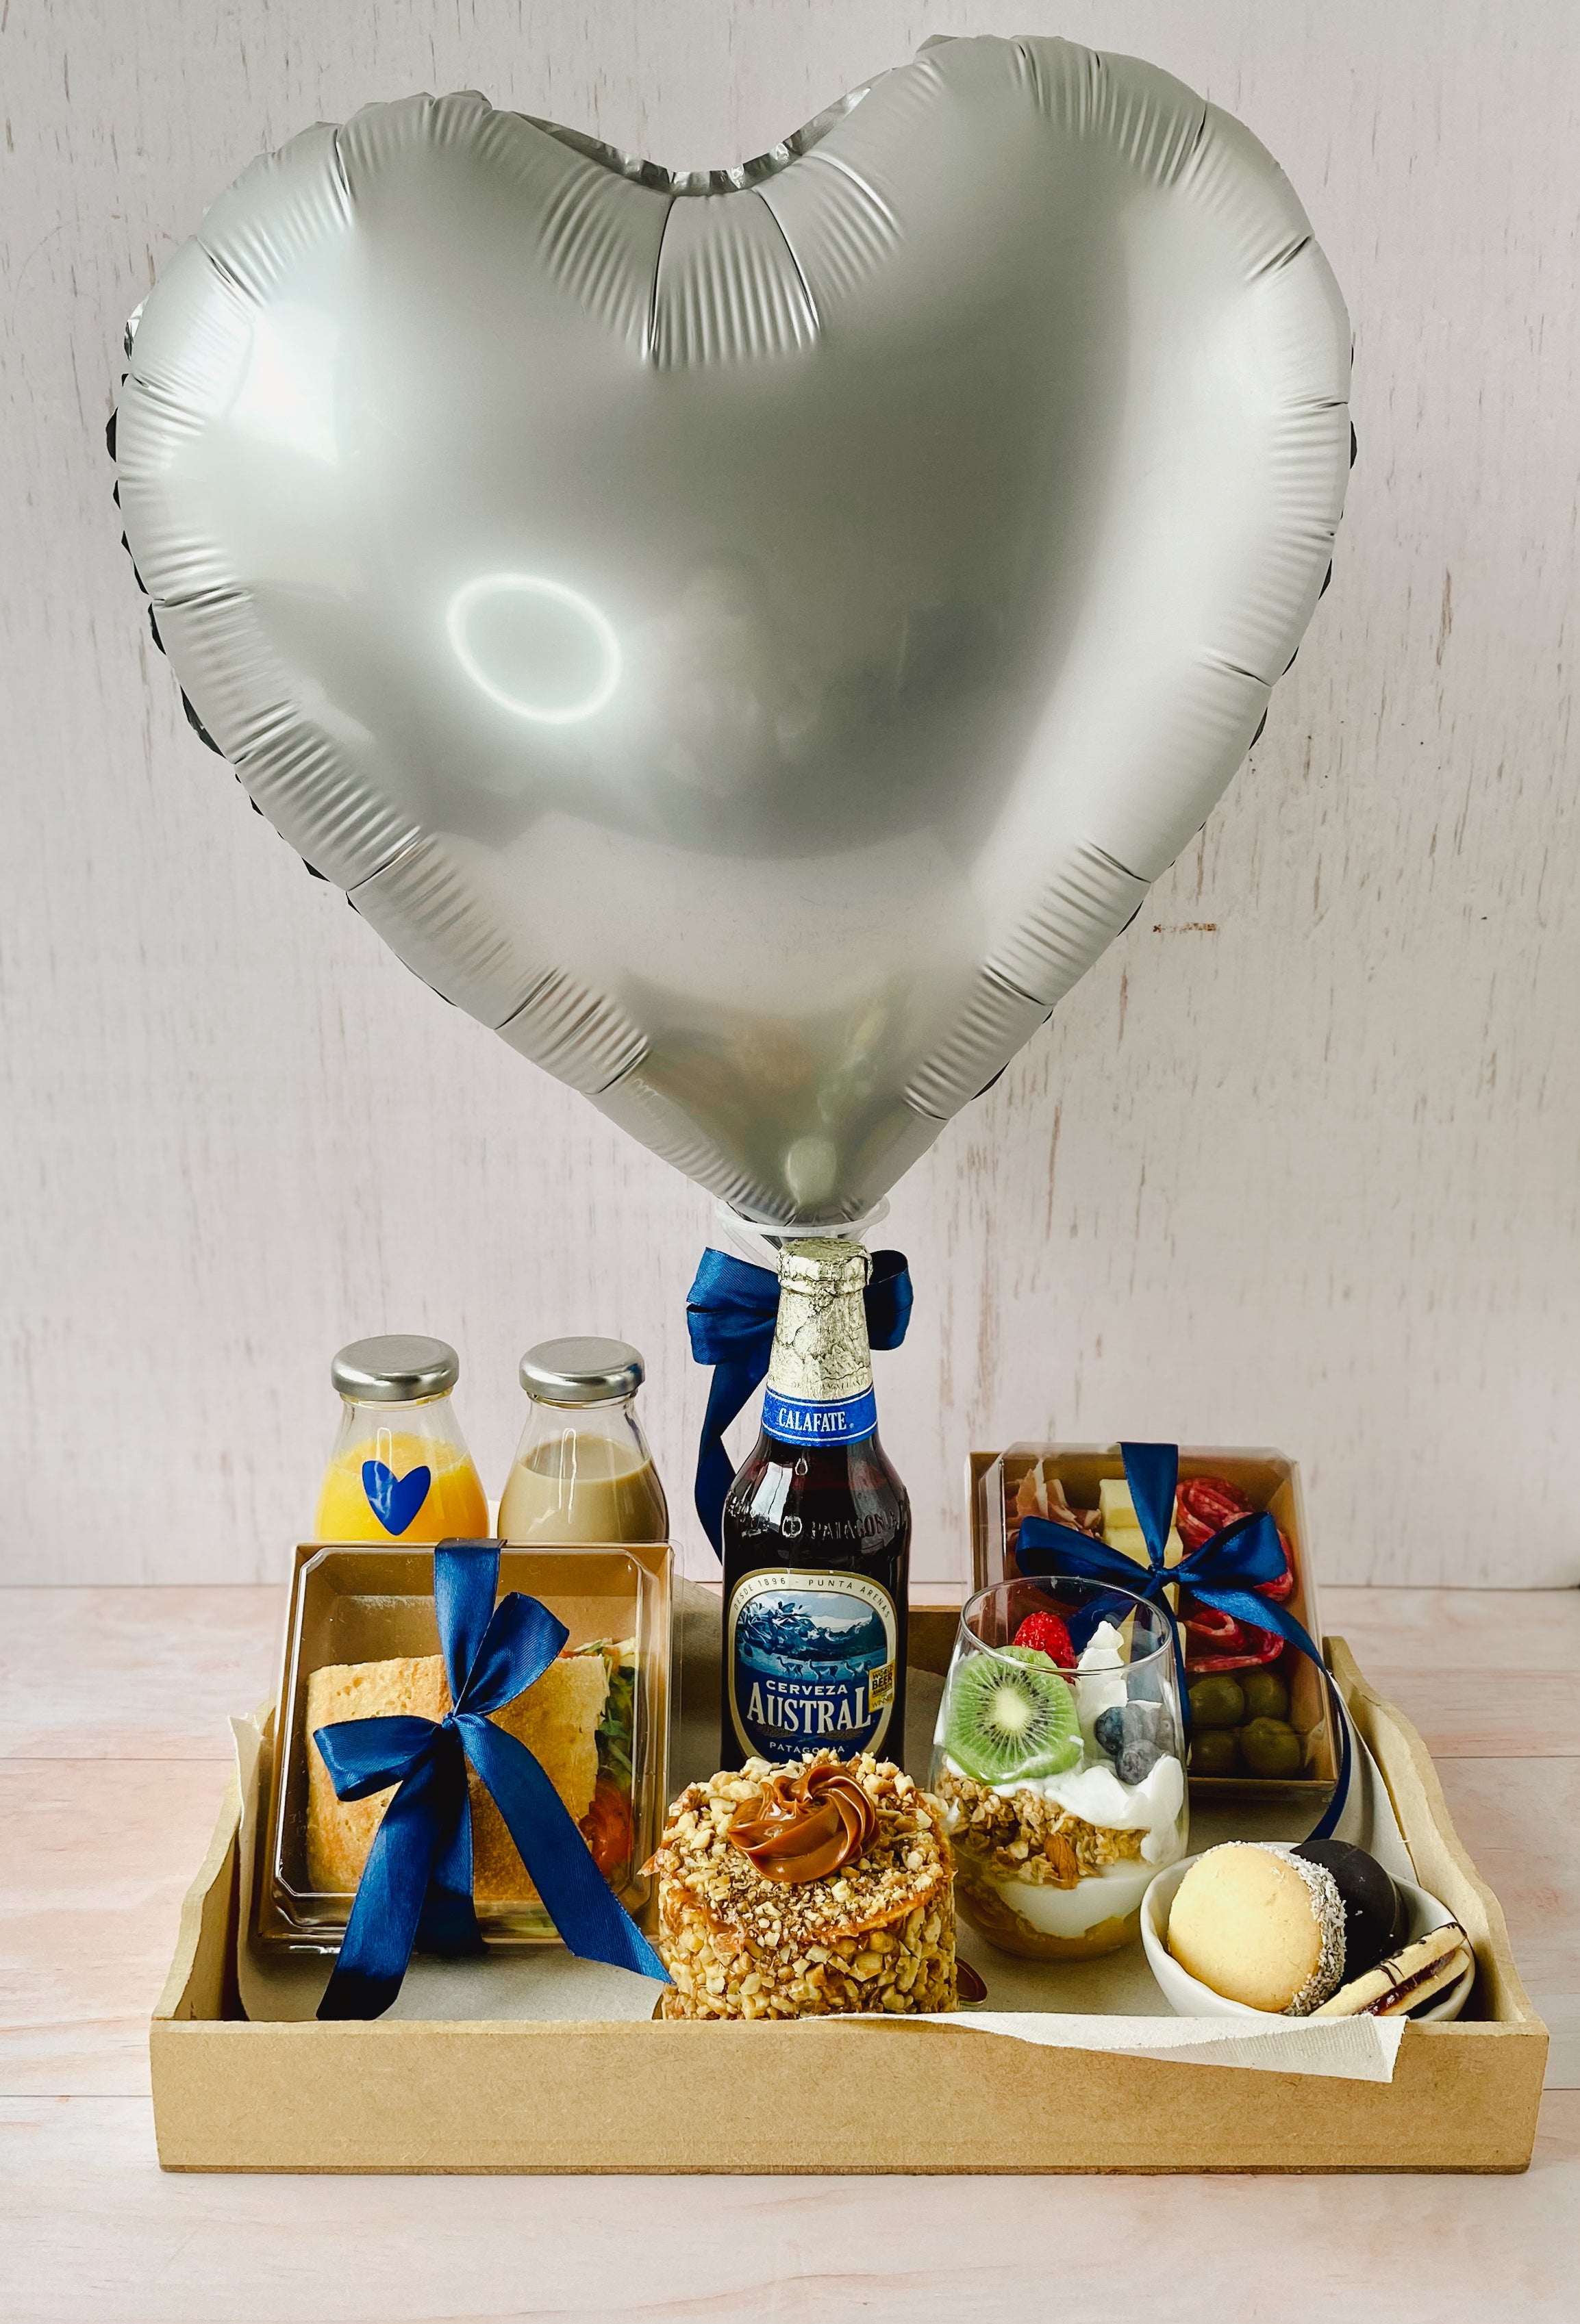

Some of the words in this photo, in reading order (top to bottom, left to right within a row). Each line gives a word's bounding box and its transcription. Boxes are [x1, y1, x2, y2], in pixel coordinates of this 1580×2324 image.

[779, 1408, 847, 1432] CALAFATE
[733, 1584, 753, 1611] DESDE
[757, 1577, 786, 1587] 1896
[808, 1579, 853, 1589] PUNTA
[860, 1586, 890, 1618] ARENAS
[766, 1680, 848, 1696] CERVEZA
[872, 1671, 893, 1691] BEER
[747, 1682, 871, 1734] AUSTRAL
[871, 1693, 893, 1708] WINNER
[769, 1741, 845, 1755] PATAGOA
